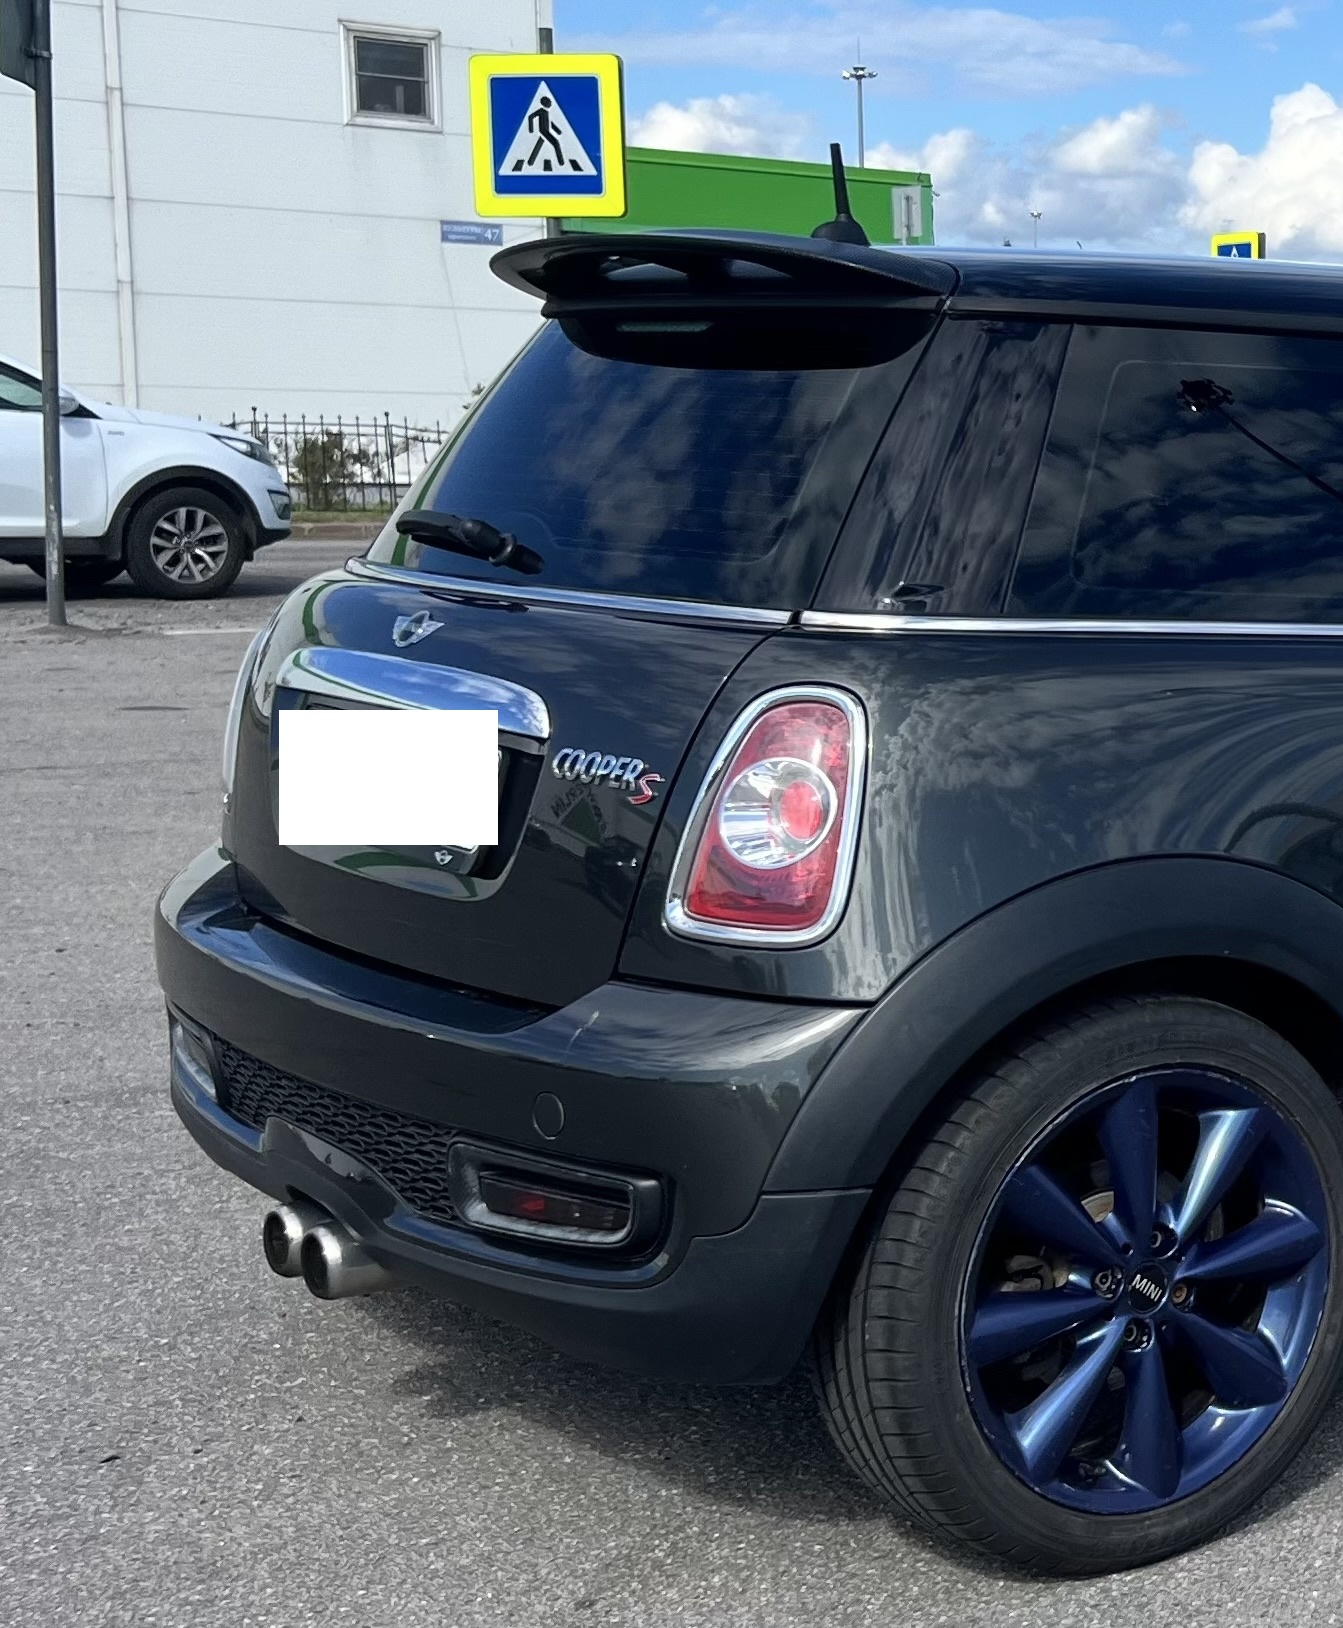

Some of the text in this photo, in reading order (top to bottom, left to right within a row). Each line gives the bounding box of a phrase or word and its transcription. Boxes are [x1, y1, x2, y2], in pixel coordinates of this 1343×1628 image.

[485, 228, 499, 241] 47
[552, 748, 661, 805] COOPER S
[1131, 1273, 1163, 1302] MINI
